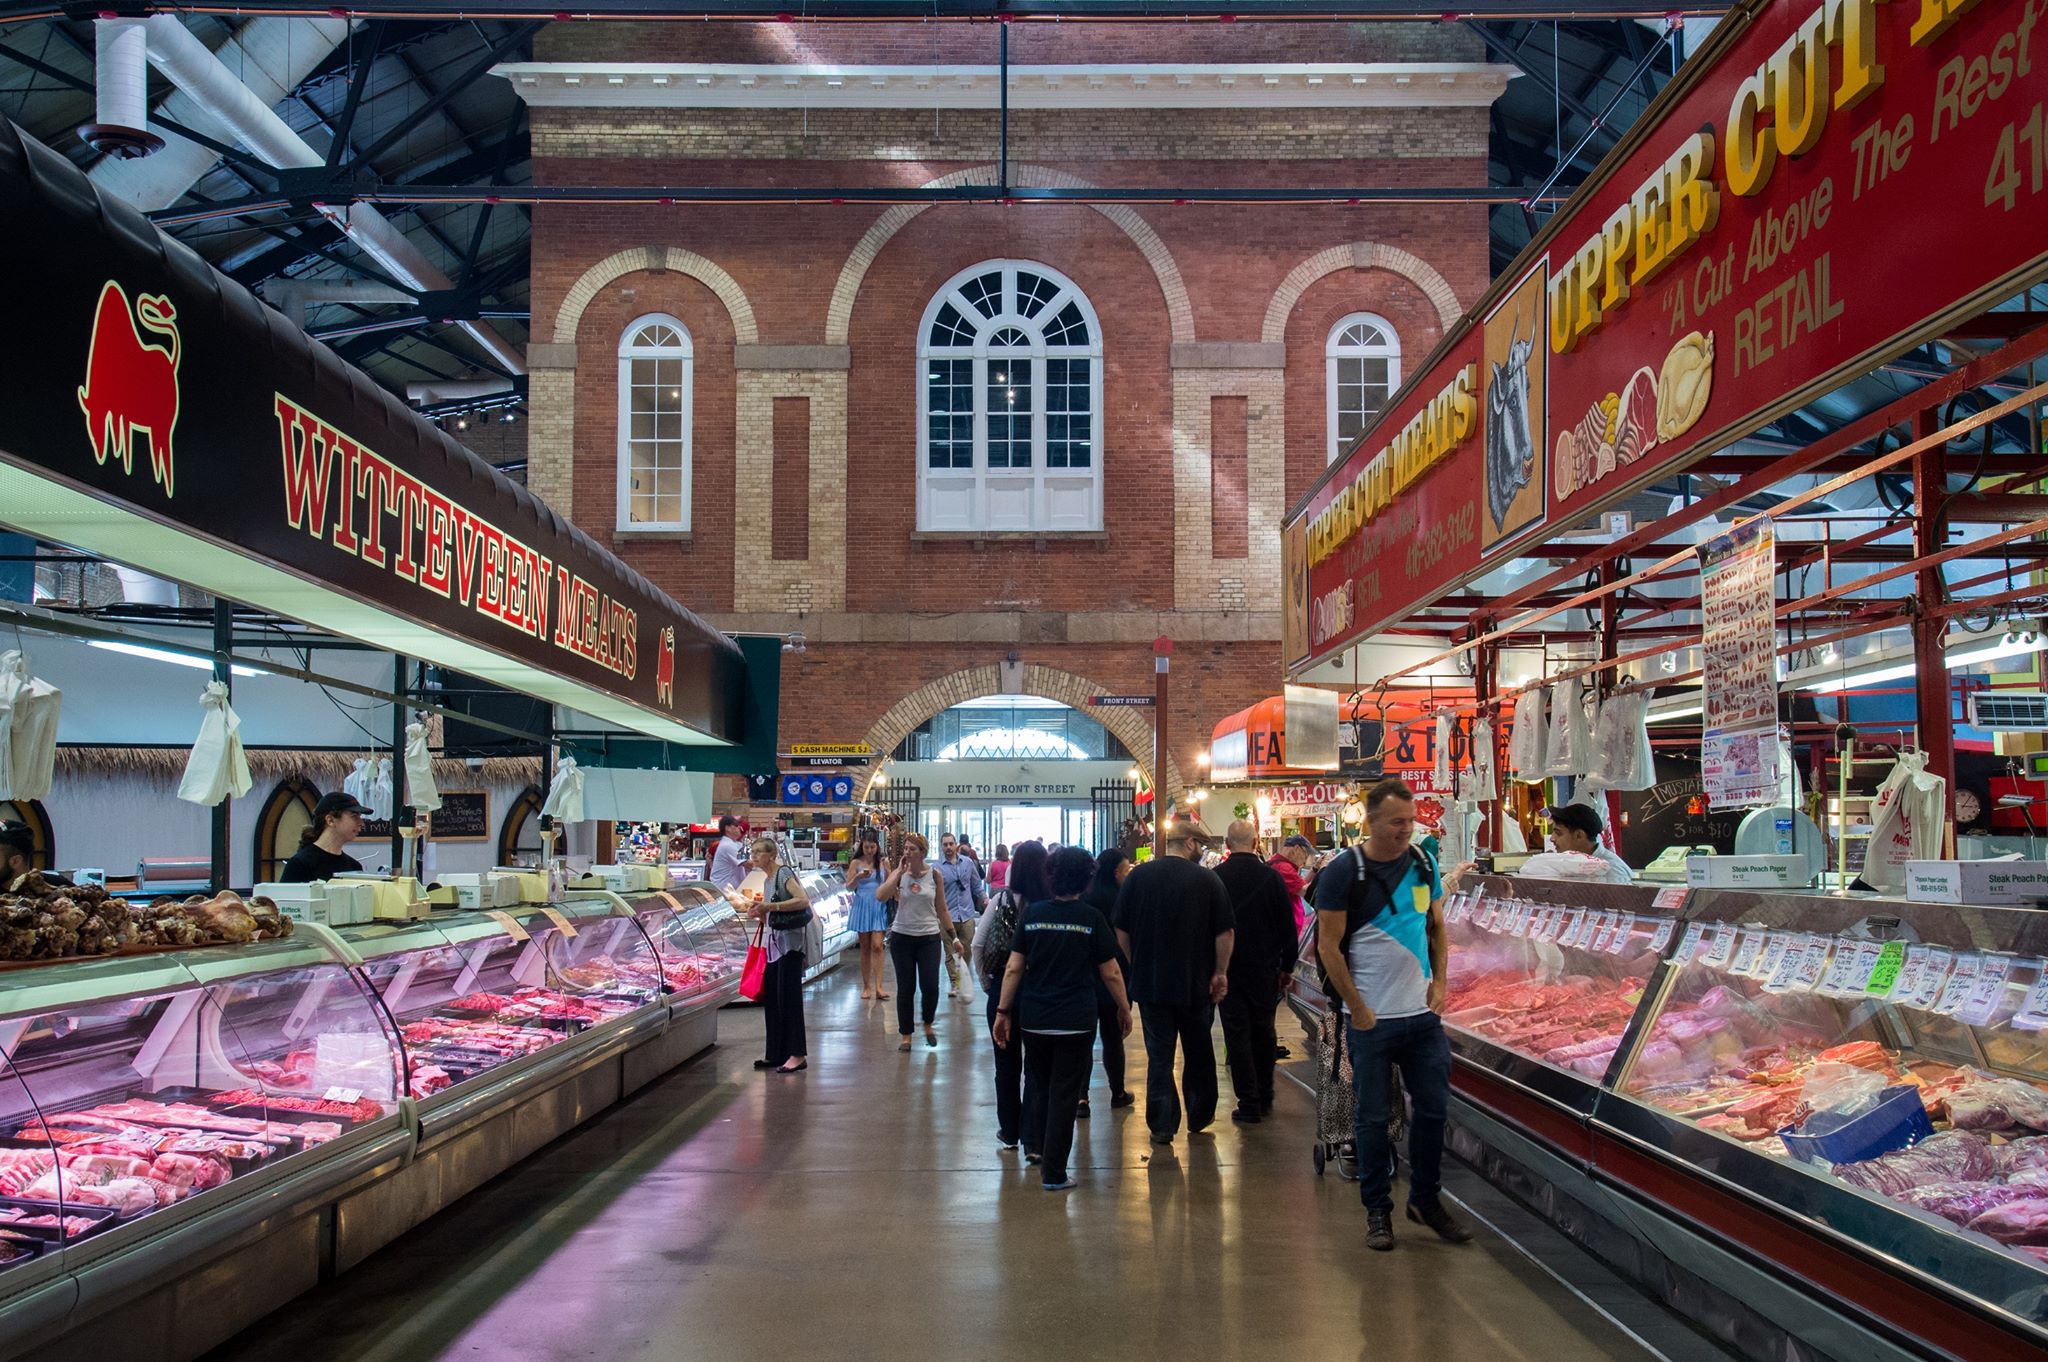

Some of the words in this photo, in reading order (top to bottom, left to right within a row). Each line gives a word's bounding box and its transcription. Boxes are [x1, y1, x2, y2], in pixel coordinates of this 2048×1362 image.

[1548, 125, 1720, 354] UPPER
[1725, 0, 1885, 196] CUT
[1694, 242, 1735, 318] Cut
[1742, 176, 1833, 284] Above
[1851, 112, 1914, 202] The
[1734, 251, 1845, 378] RETAIL
[1306, 484, 1358, 569] UPPER
[1354, 446, 1394, 528] CUT
[1391, 364, 1478, 497] MEATS
[275, 391, 552, 641] WITTEVEEN
[555, 564, 638, 681] MEATS
[800, 745, 820, 753] CASH
[822, 745, 856, 753] MACHINE
[1401, 770, 1426, 780] BEST
[947, 785, 972, 794] EXIT
[976, 785, 990, 794] TO
[994, 785, 1030, 794] FRONT
[1034, 785, 1075, 794] STREET
[1416, 781, 1427, 791] IN
[1674, 823, 1686, 838] 3
[1707, 821, 1732, 838] $10
[1732, 865, 1749, 873] Steak
[1750, 865, 1768, 873] Peach
[1769, 865, 1787, 874] Paper
[1988, 874, 2010, 883] Steak
[2012, 874, 2036, 883] Peach
